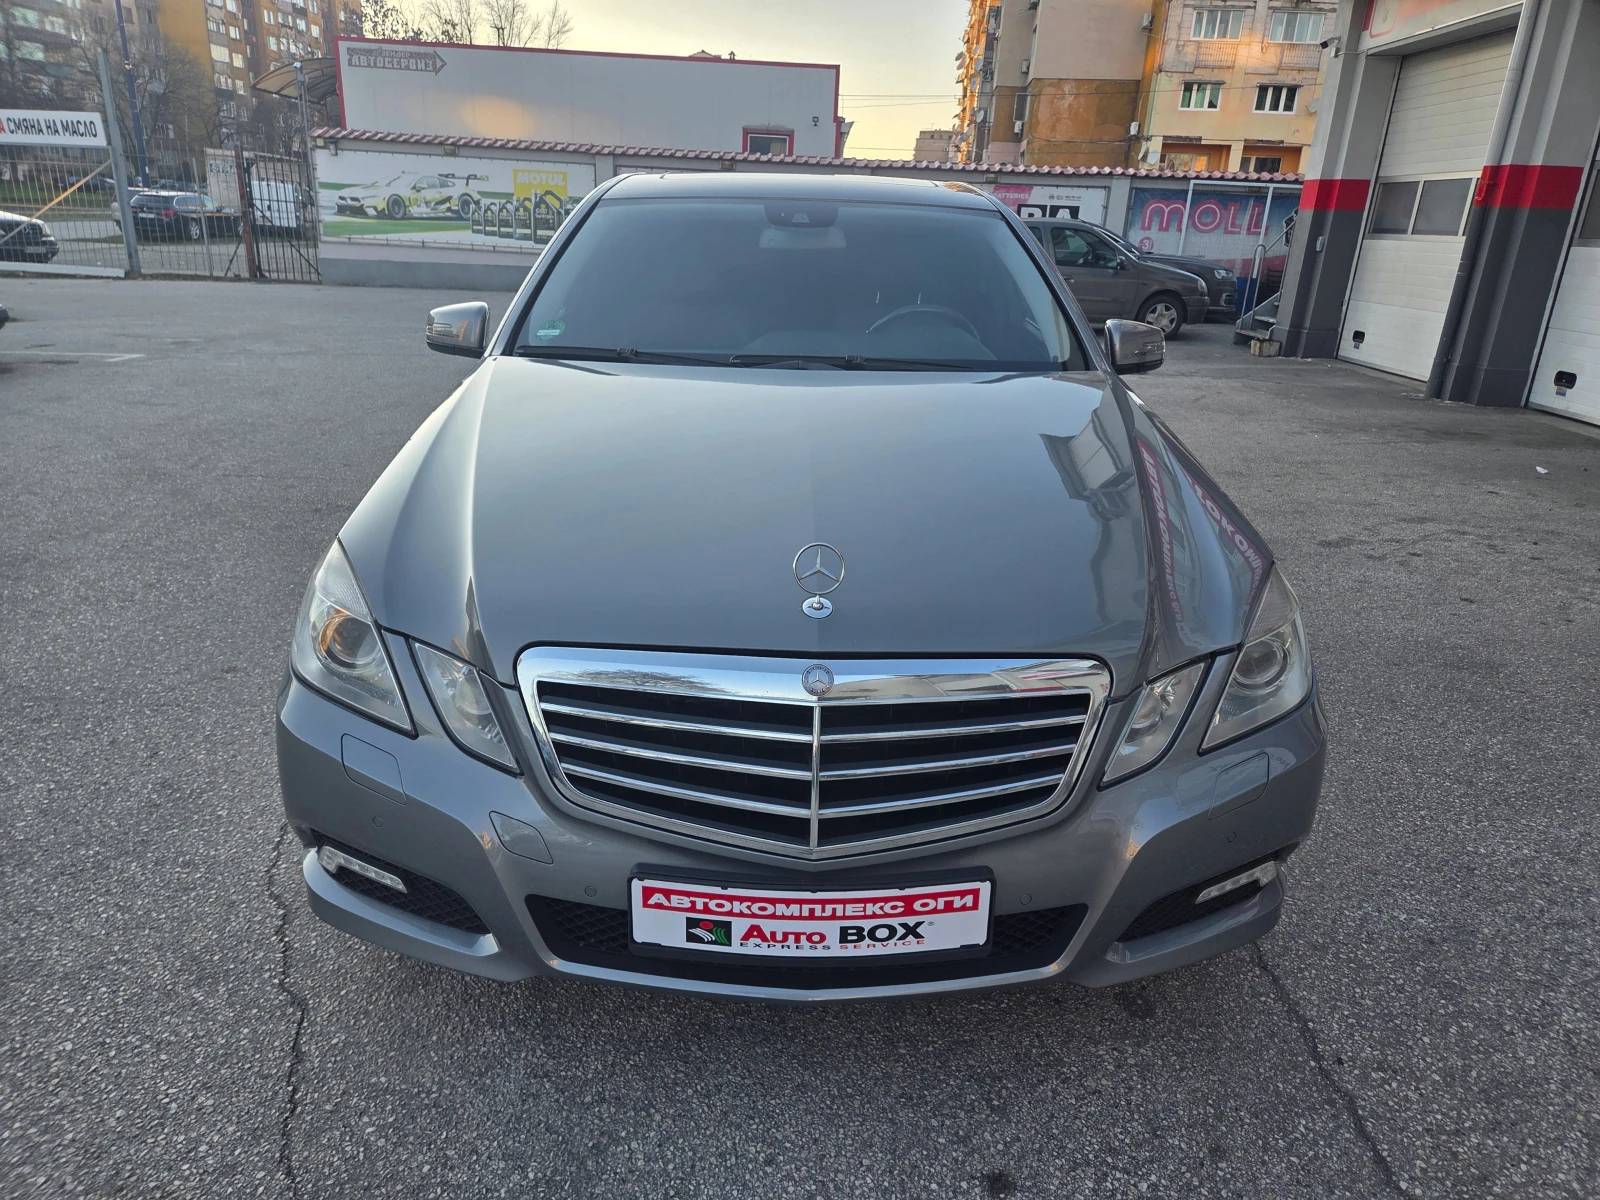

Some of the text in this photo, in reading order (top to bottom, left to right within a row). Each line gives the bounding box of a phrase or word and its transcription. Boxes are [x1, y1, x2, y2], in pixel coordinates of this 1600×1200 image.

[351, 55, 434, 71] АВТОСЕРВИЗ
[6, 117, 44, 136] СМЯНА
[44, 118, 61, 136] НА
[60, 119, 98, 138] МАСЛО
[515, 171, 566, 187] MOTUL
[647, 893, 974, 918] АВТОКОМПЛЕКС ОГИ
[739, 939, 926, 951] EXPRESS SERVICE
